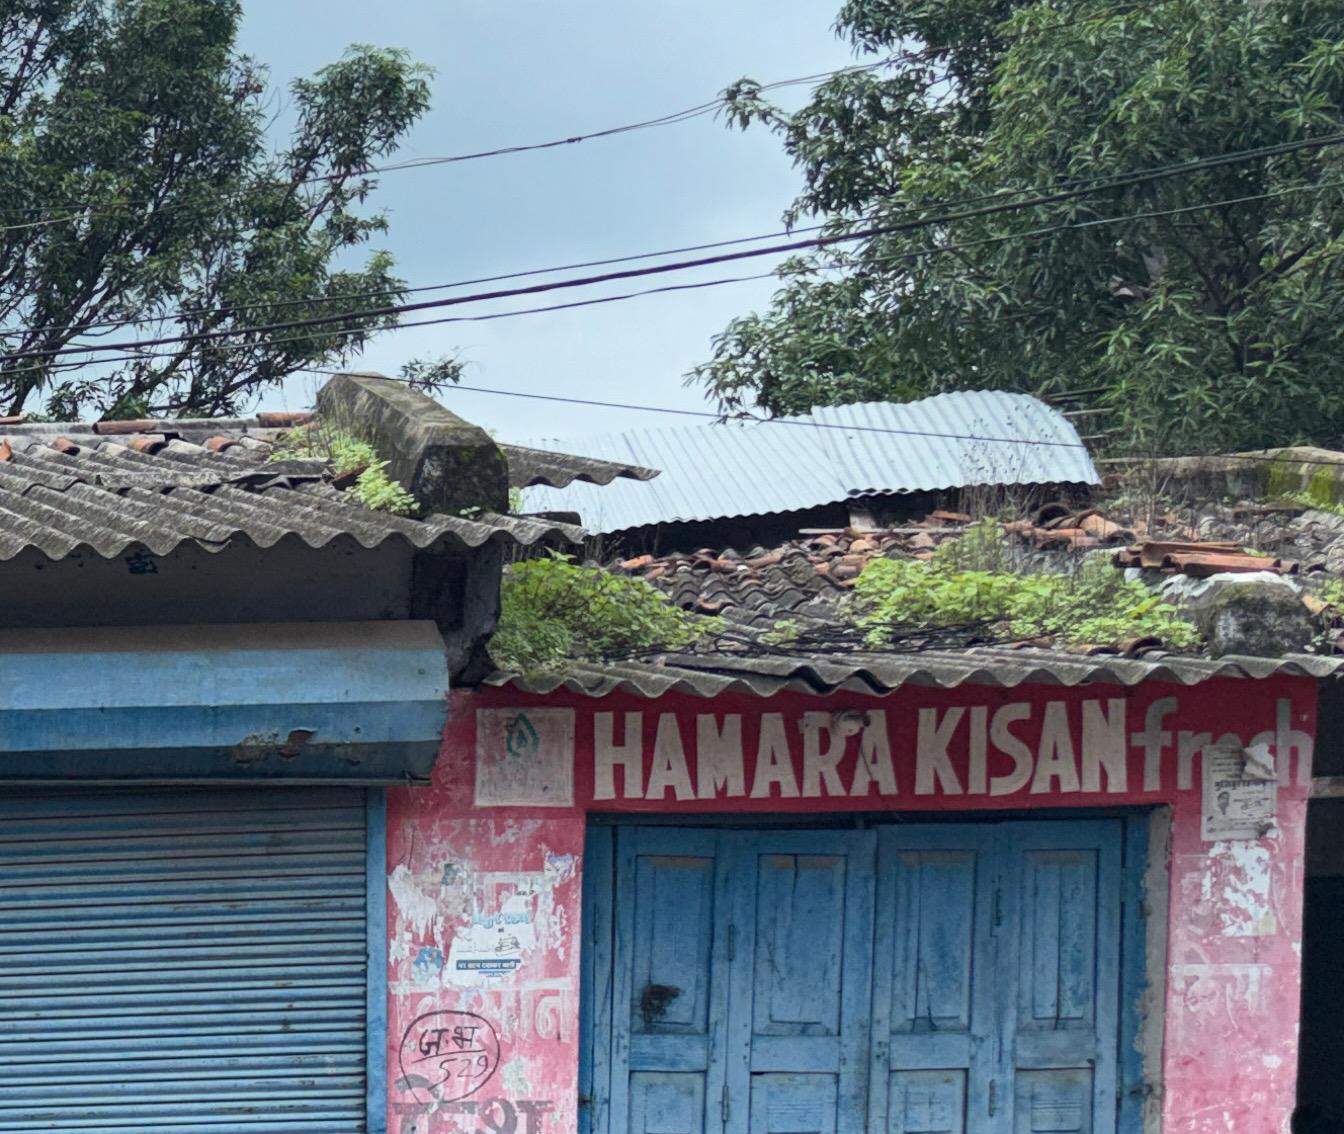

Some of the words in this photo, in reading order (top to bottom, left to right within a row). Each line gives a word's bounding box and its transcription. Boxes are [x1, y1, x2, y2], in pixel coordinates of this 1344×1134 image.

[593, 709, 899, 801] HAMARA
[914, 697, 1129, 797] KISAN
[1130, 697, 1315, 792] frh
[427, 1055, 489, 1090] 529
